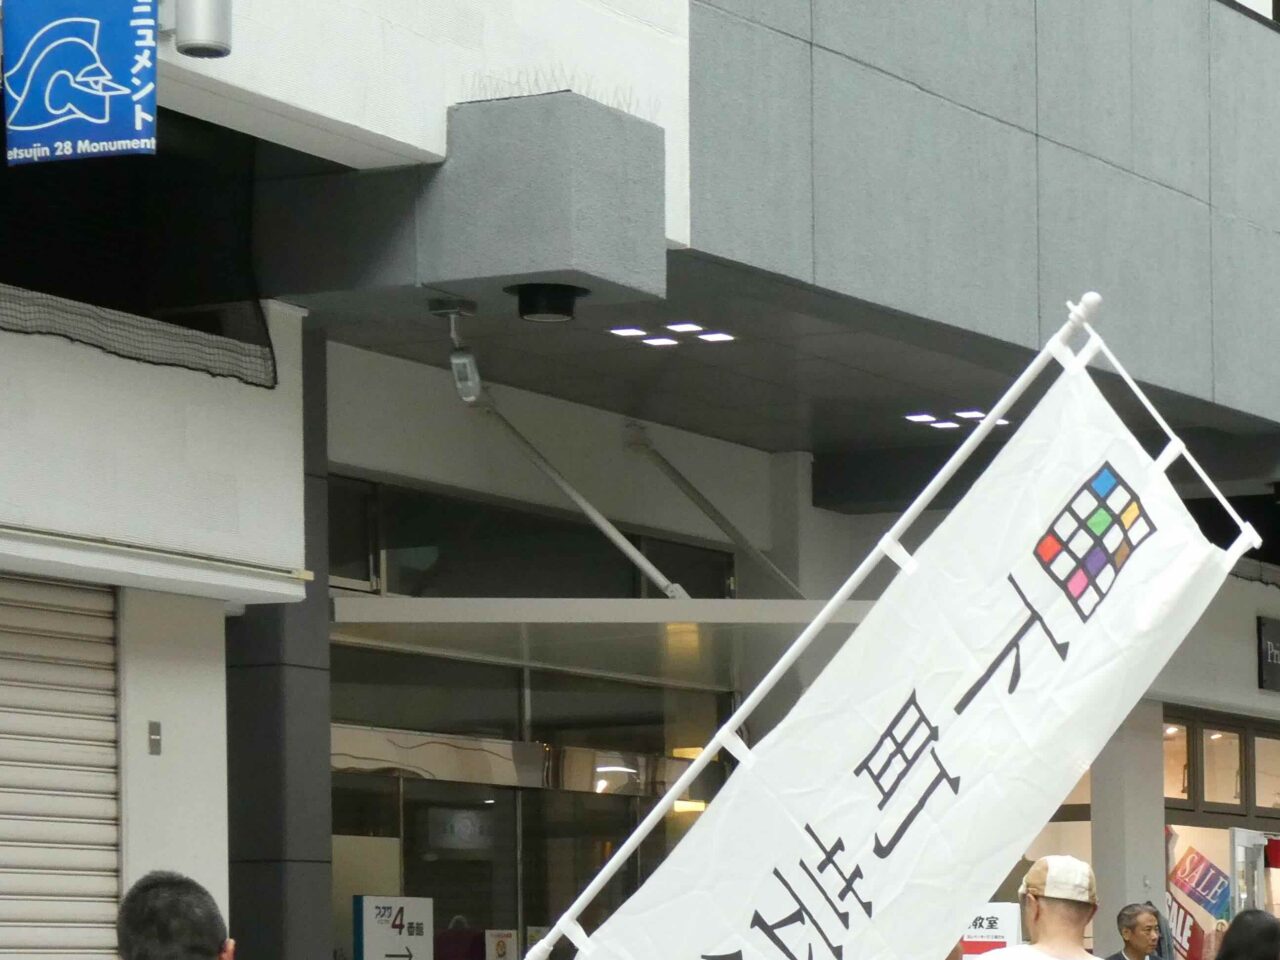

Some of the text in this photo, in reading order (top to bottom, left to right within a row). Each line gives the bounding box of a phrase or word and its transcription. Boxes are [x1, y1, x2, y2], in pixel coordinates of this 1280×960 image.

[130, 0, 156, 131] ニュメント
[54, 141, 73, 156] 28
[77, 137, 156, 153] Monument
[1178, 853, 1229, 904] SALE
